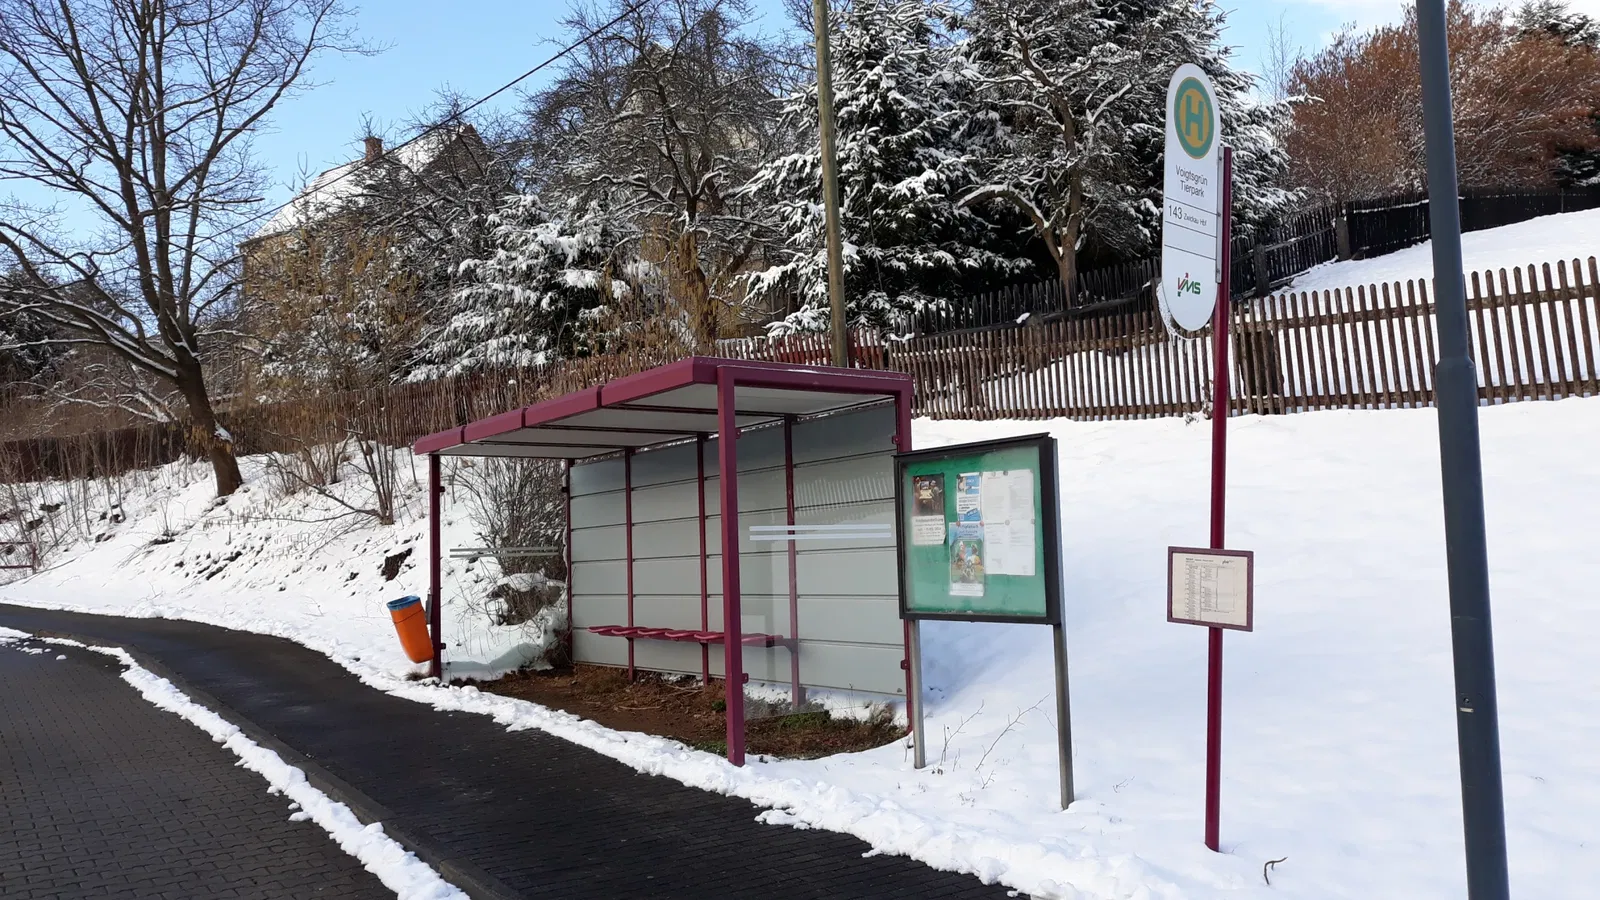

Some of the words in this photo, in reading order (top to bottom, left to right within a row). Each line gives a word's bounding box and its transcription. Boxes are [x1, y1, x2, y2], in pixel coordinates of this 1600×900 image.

[1185, 94, 1204, 142] H
[1175, 164, 1208, 186] Voigtsgrün
[1180, 179, 1205, 198] Tierpark
[1168, 204, 1183, 220] 143
[1177, 275, 1201, 296] VMS
